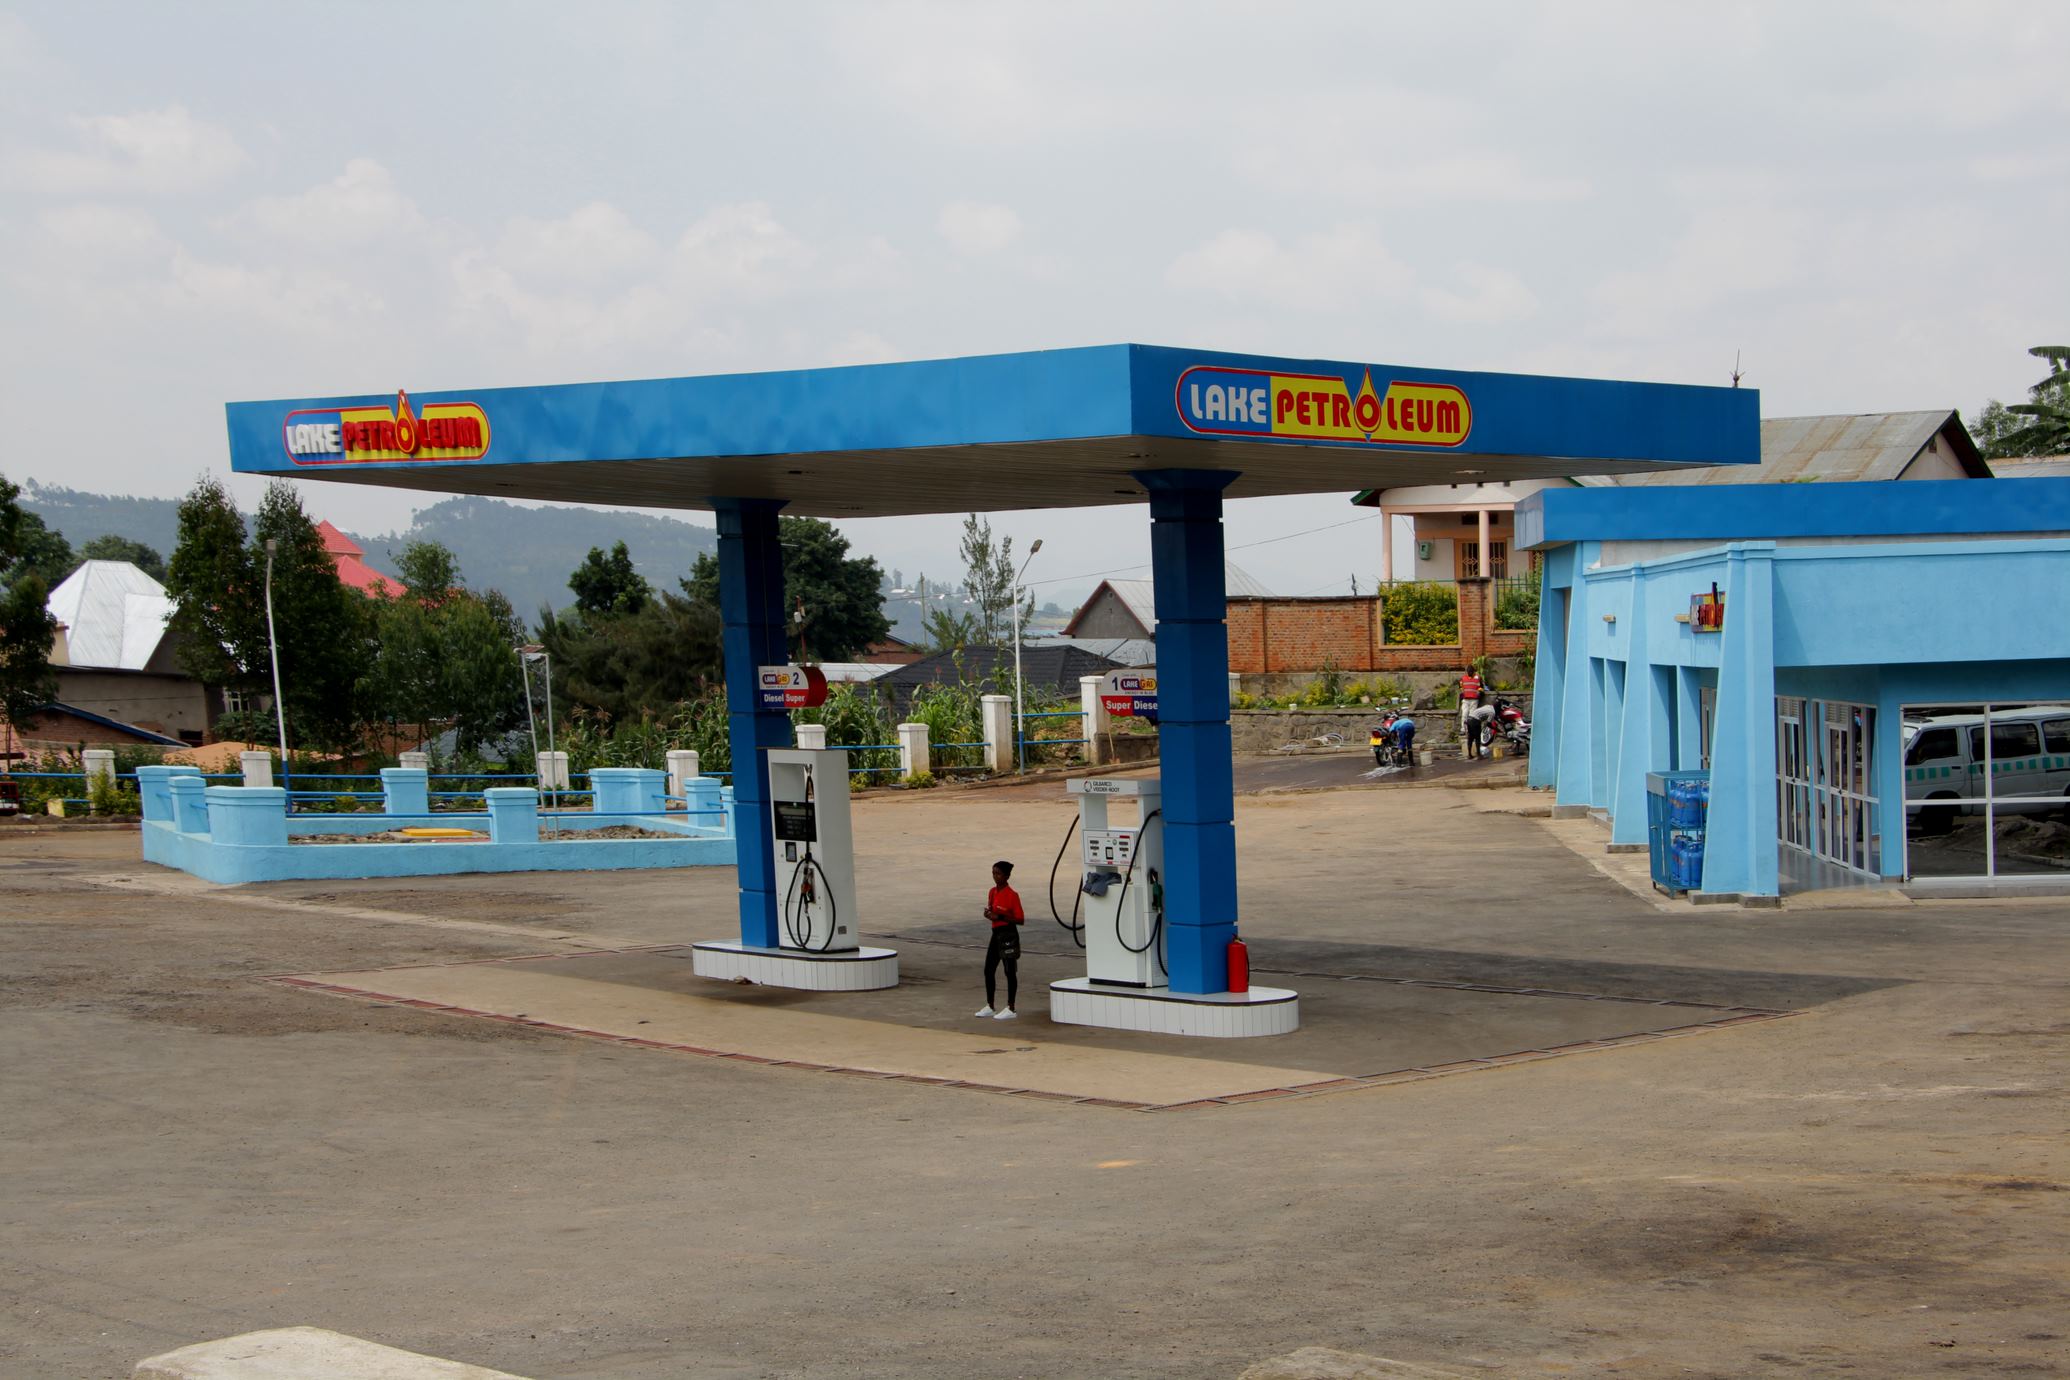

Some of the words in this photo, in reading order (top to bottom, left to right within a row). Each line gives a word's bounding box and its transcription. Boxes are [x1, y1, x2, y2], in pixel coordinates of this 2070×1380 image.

[1190, 383, 1267, 424] LAKE
[1276, 388, 1461, 434] PETROLEUM
[286, 423, 341, 454] LAKE
[342, 416, 482, 454] PETROLEUM
[793, 672, 799, 685] 2
[1112, 677, 1118, 691] 1
[1123, 680, 1138, 688] LAKE
[764, 694, 784, 702] Diesel
[785, 694, 805, 704] Super
[1106, 700, 1131, 711] Super
[1134, 700, 1158, 710] Diese
